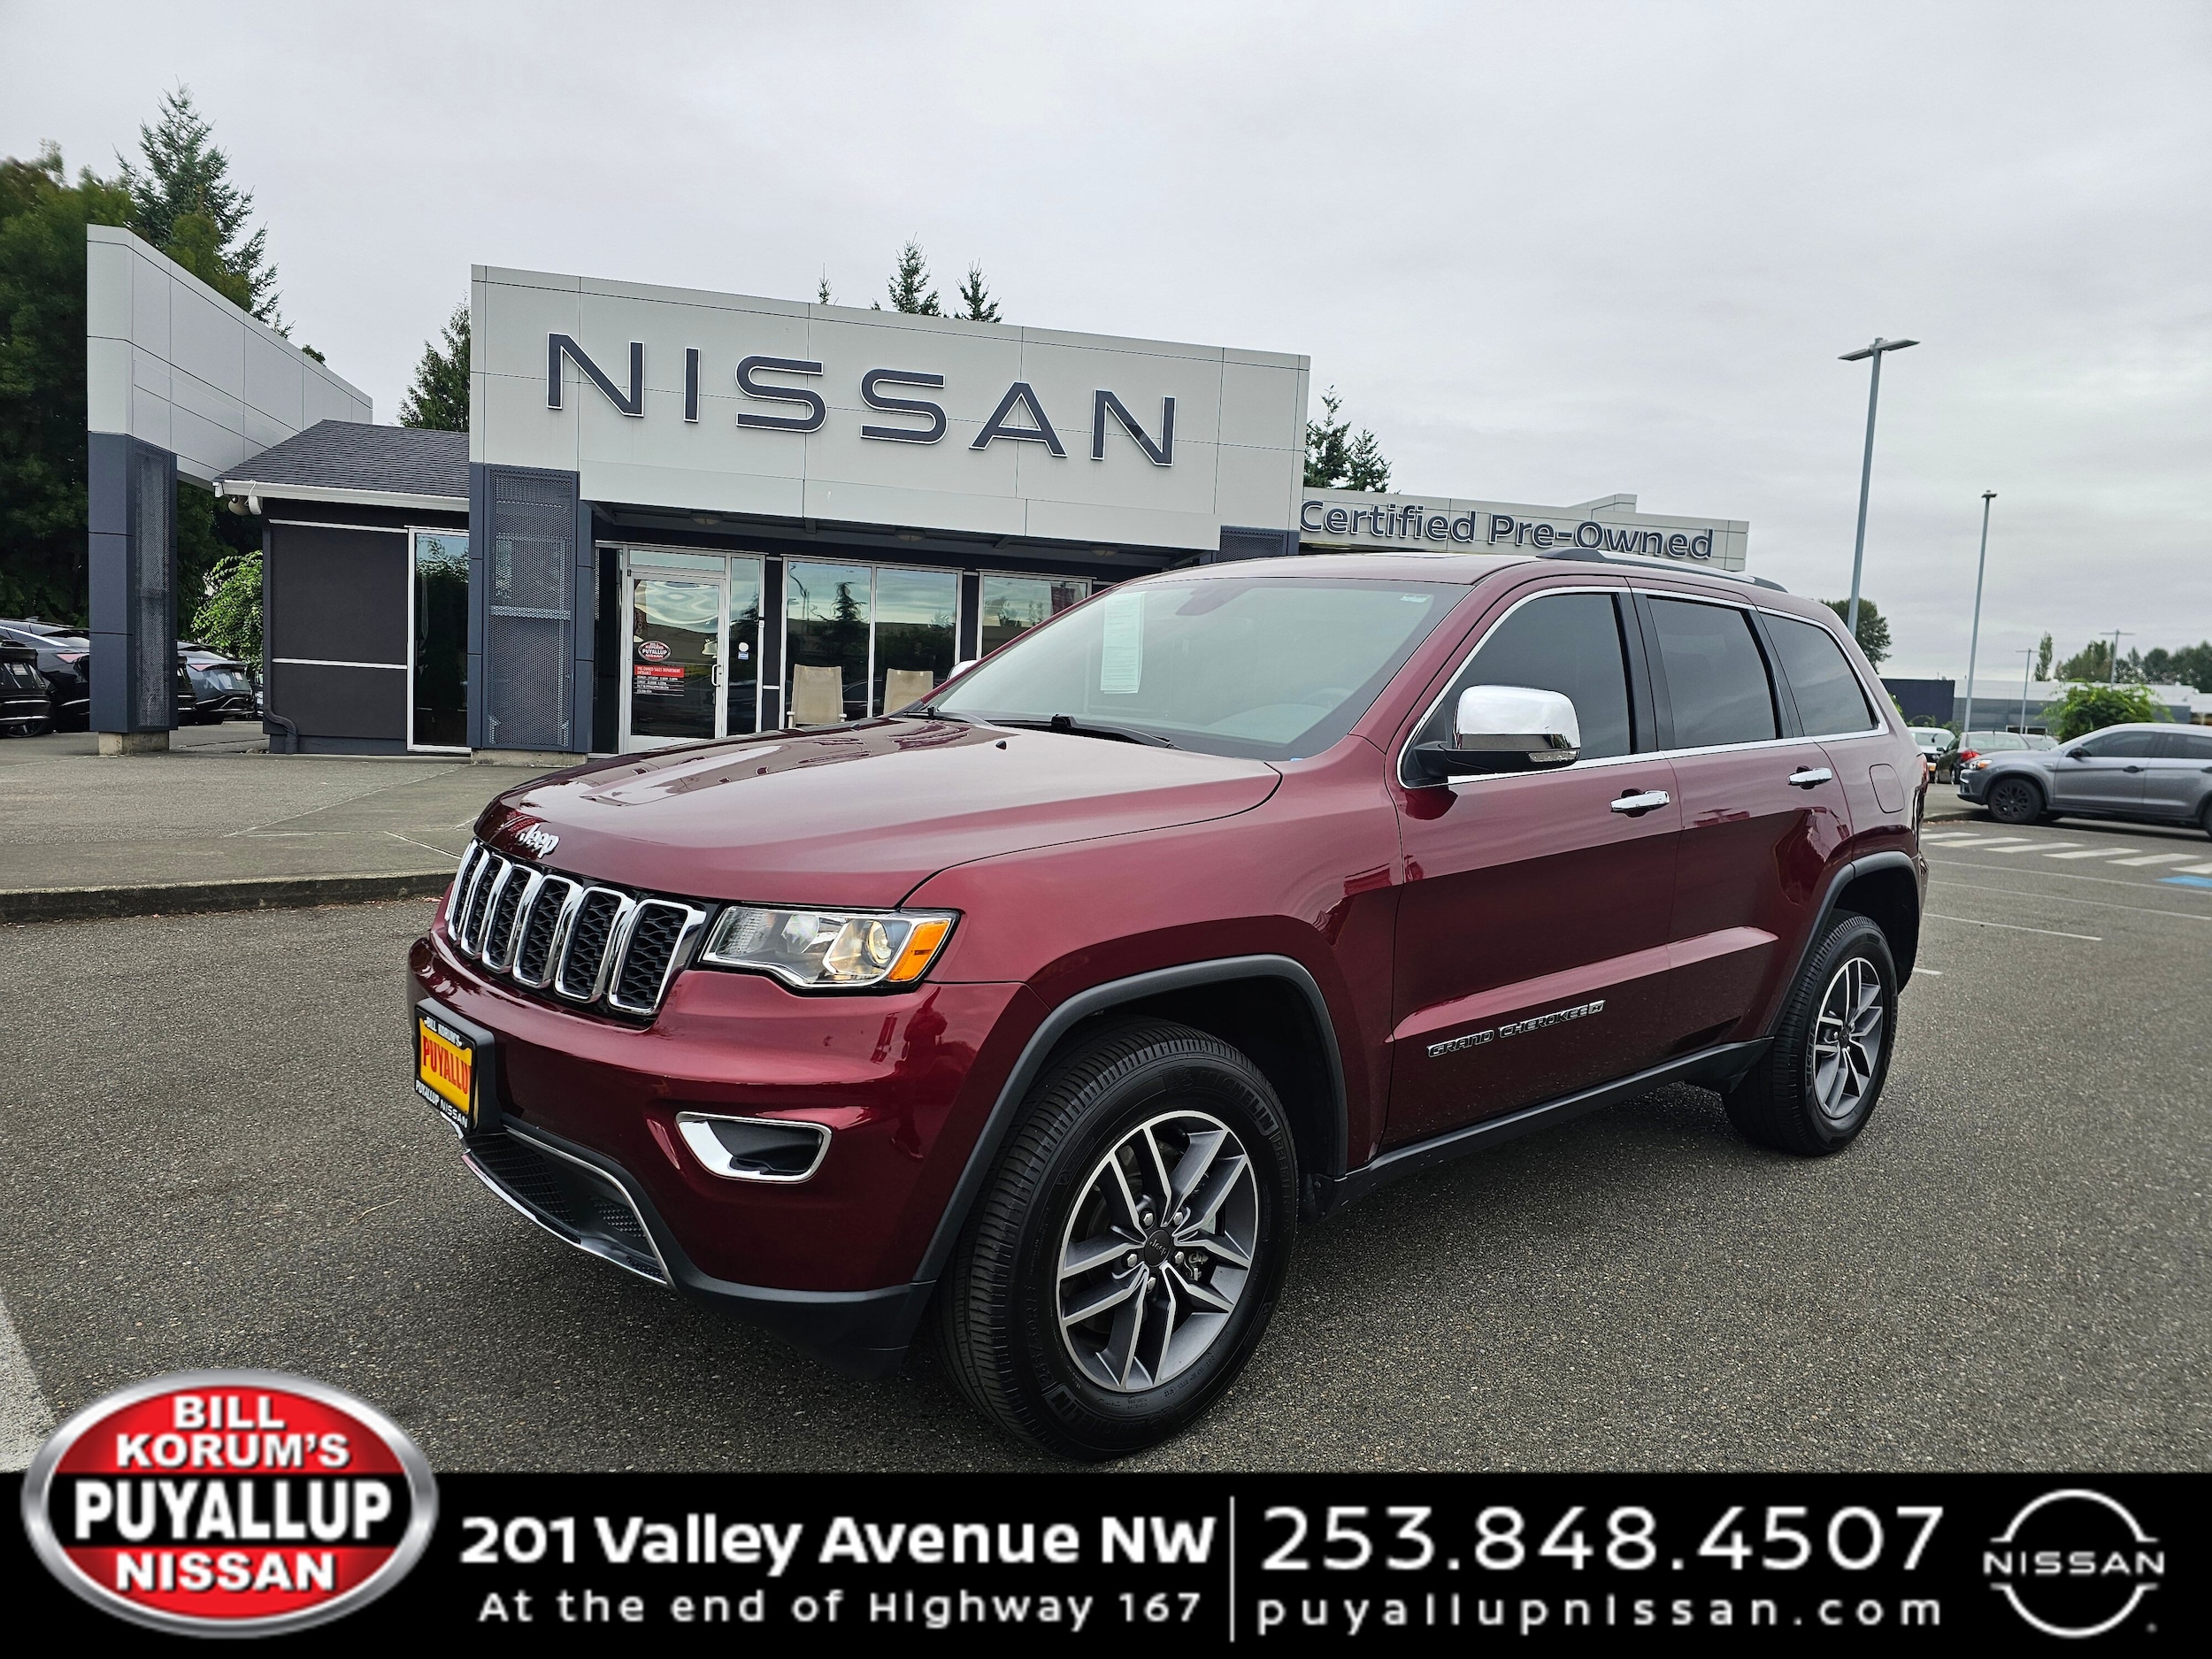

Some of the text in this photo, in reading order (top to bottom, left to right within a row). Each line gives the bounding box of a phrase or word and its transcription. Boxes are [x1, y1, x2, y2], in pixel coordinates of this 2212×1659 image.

[547, 332, 1177, 468] NISSAN
[1300, 499, 1714, 559] Certified Pre-Owned
[518, 823, 560, 858] Jeep
[1427, 1030, 1494, 1057] GRAND
[1499, 1004, 1589, 1038] CHEROKEE
[423, 1035, 472, 1094] PUYALLU
[416, 1079, 468, 1128] PUYALLUP NISSAN
[1198, 1069, 1276, 1133] MICHELIN
[1148, 1238, 1167, 1256] Jeep
